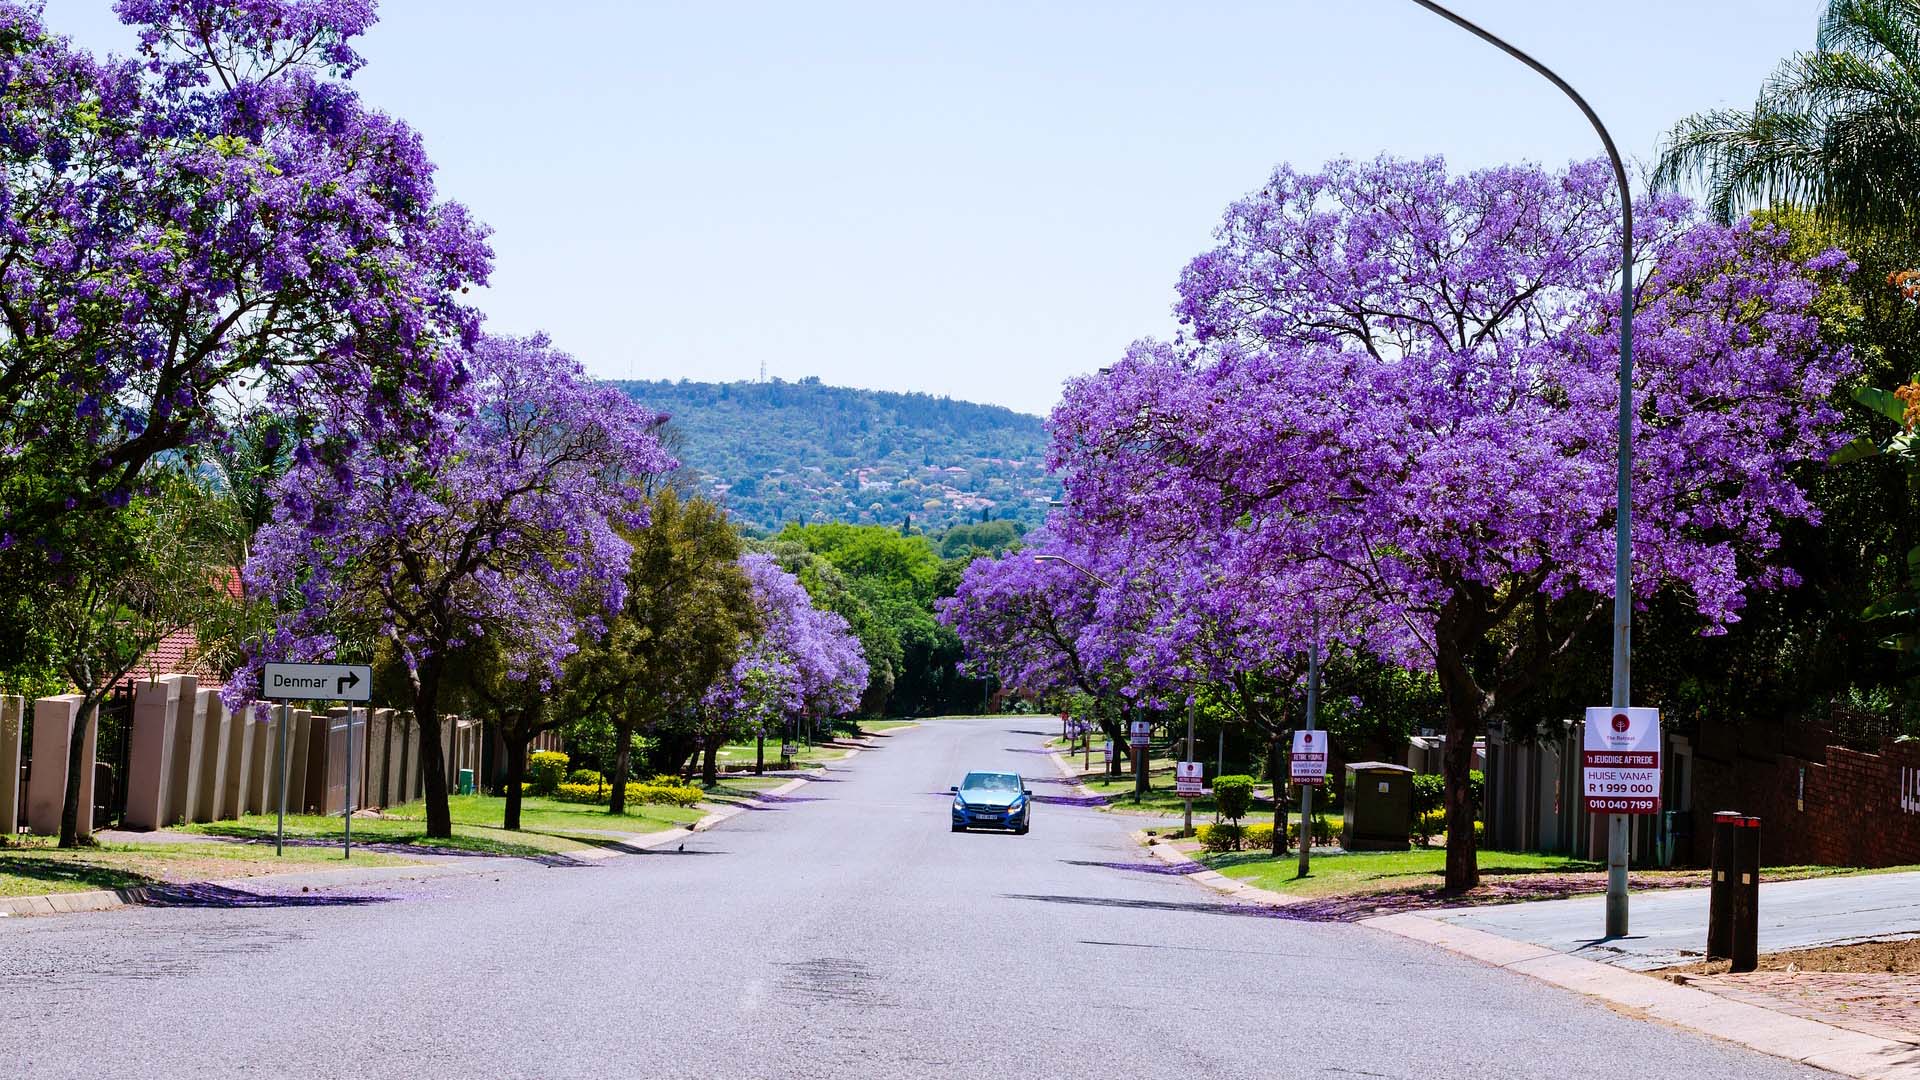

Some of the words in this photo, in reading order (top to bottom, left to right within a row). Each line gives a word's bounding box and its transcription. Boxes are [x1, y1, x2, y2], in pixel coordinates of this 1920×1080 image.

[273, 674, 328, 688] Denmar
[1594, 755, 1623, 764] JEUGDIGE
[1624, 755, 1654, 764] AFTREDE
[1588, 771, 1617, 780] HUISE
[1619, 772, 1653, 781] VANAF
[1589, 783, 1597, 792] R
[1606, 784, 1627, 793] 999
[1630, 784, 1653, 793] 000
[1589, 799, 1606, 809] 010
[1607, 800, 1628, 809] 040
[1630, 800, 1653, 809] 7199
